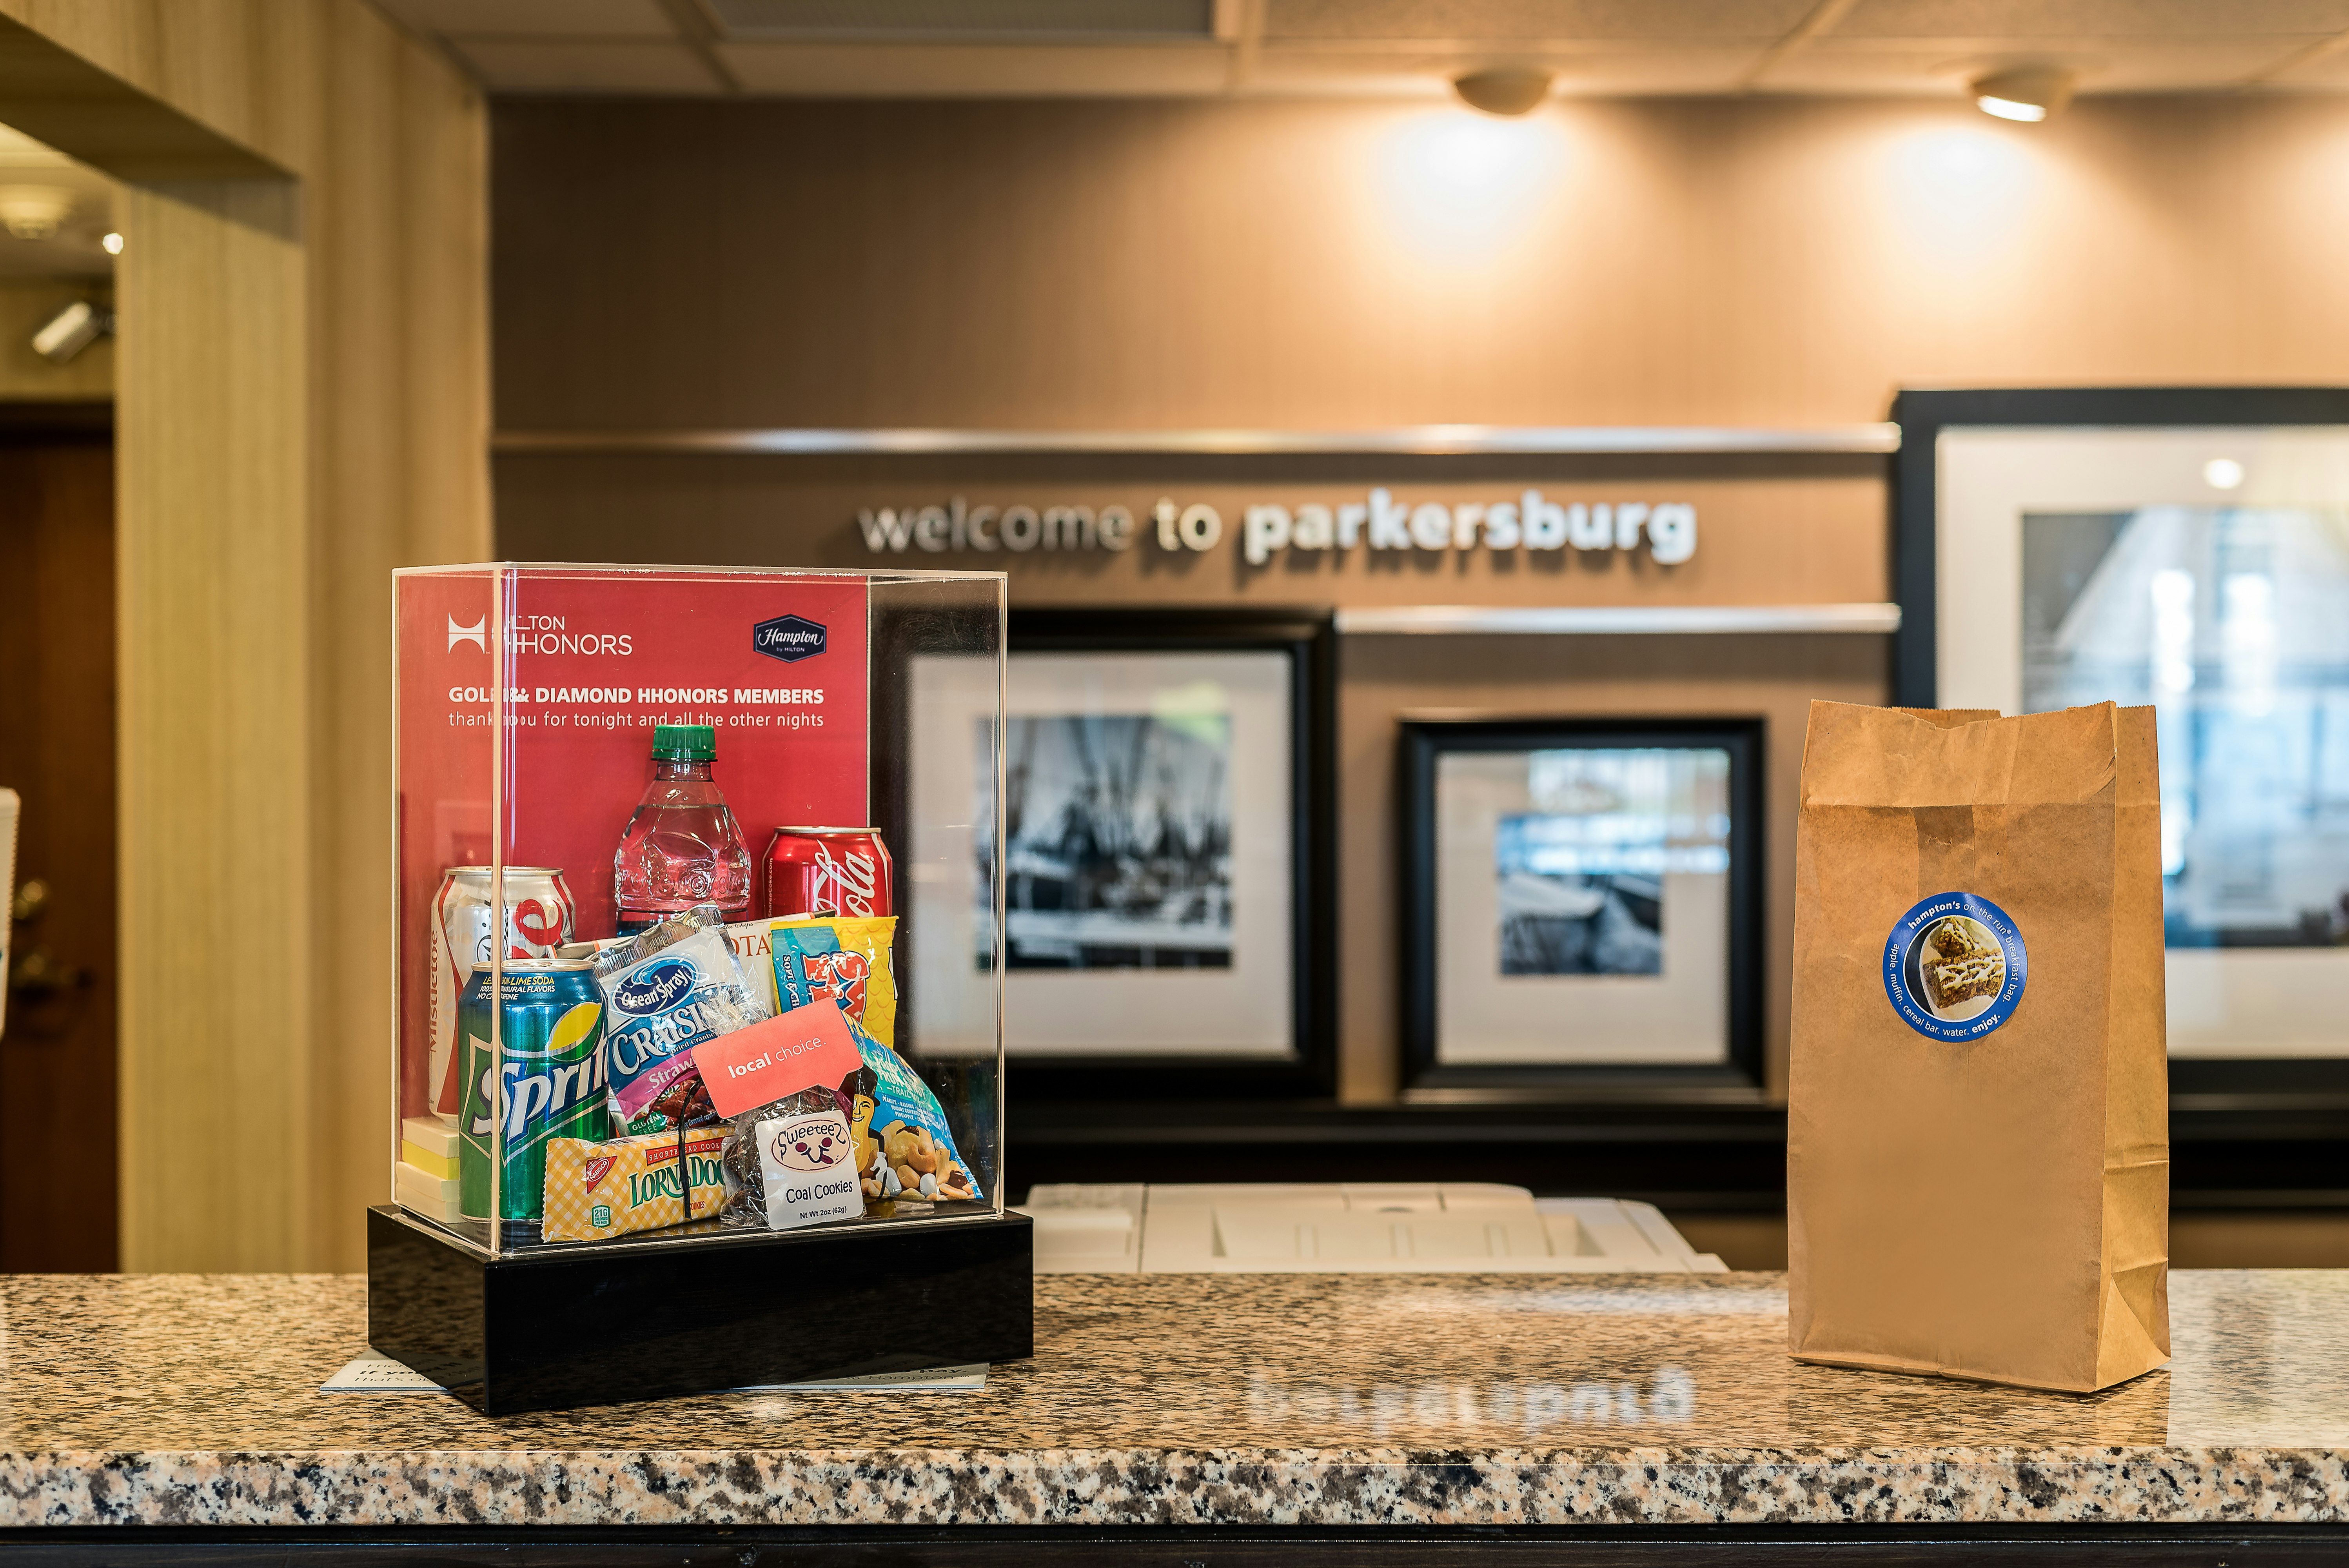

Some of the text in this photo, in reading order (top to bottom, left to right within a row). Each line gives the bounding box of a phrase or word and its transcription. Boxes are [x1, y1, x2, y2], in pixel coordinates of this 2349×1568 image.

[858, 489, 1697, 566] welcome to parkersburg
[758, 628, 823, 648] Hampton
[536, 687, 632, 703] DIAMOND
[638, 688, 728, 704] HHONORS
[734, 688, 824, 704] MEMBERS
[544, 711, 567, 726] for
[574, 711, 632, 730] tonight
[639, 712, 668, 727] and
[674, 712, 692, 726] all
[698, 712, 723, 727] the
[729, 712, 770, 727] other
[777, 712, 824, 730] nights
[1908, 901, 1960, 929] hampton's
[1963, 904, 1975, 913] on
[1979, 907, 1993, 921] the
[2005, 935, 2020, 981] breakfast
[532, 976, 555, 985] SODA
[621, 967, 687, 1007] Ocean Spray
[1889, 944, 2001, 1036] apple. muffin. cereal bar. water. enjoy.
[2003, 984, 2018, 1002] bag.
[728, 1037, 826, 1078] local choice.
[470, 1021, 607, 1141] Sprit
[895, 1111, 914, 1120] PINEAPPLE
[649, 1141, 722, 1161] SHORTBEAD COOK
[590, 1161, 607, 1180] NABISCO
[786, 1181, 853, 1203] Coal Cookies
[832, 1206, 847, 1215] (62g)
